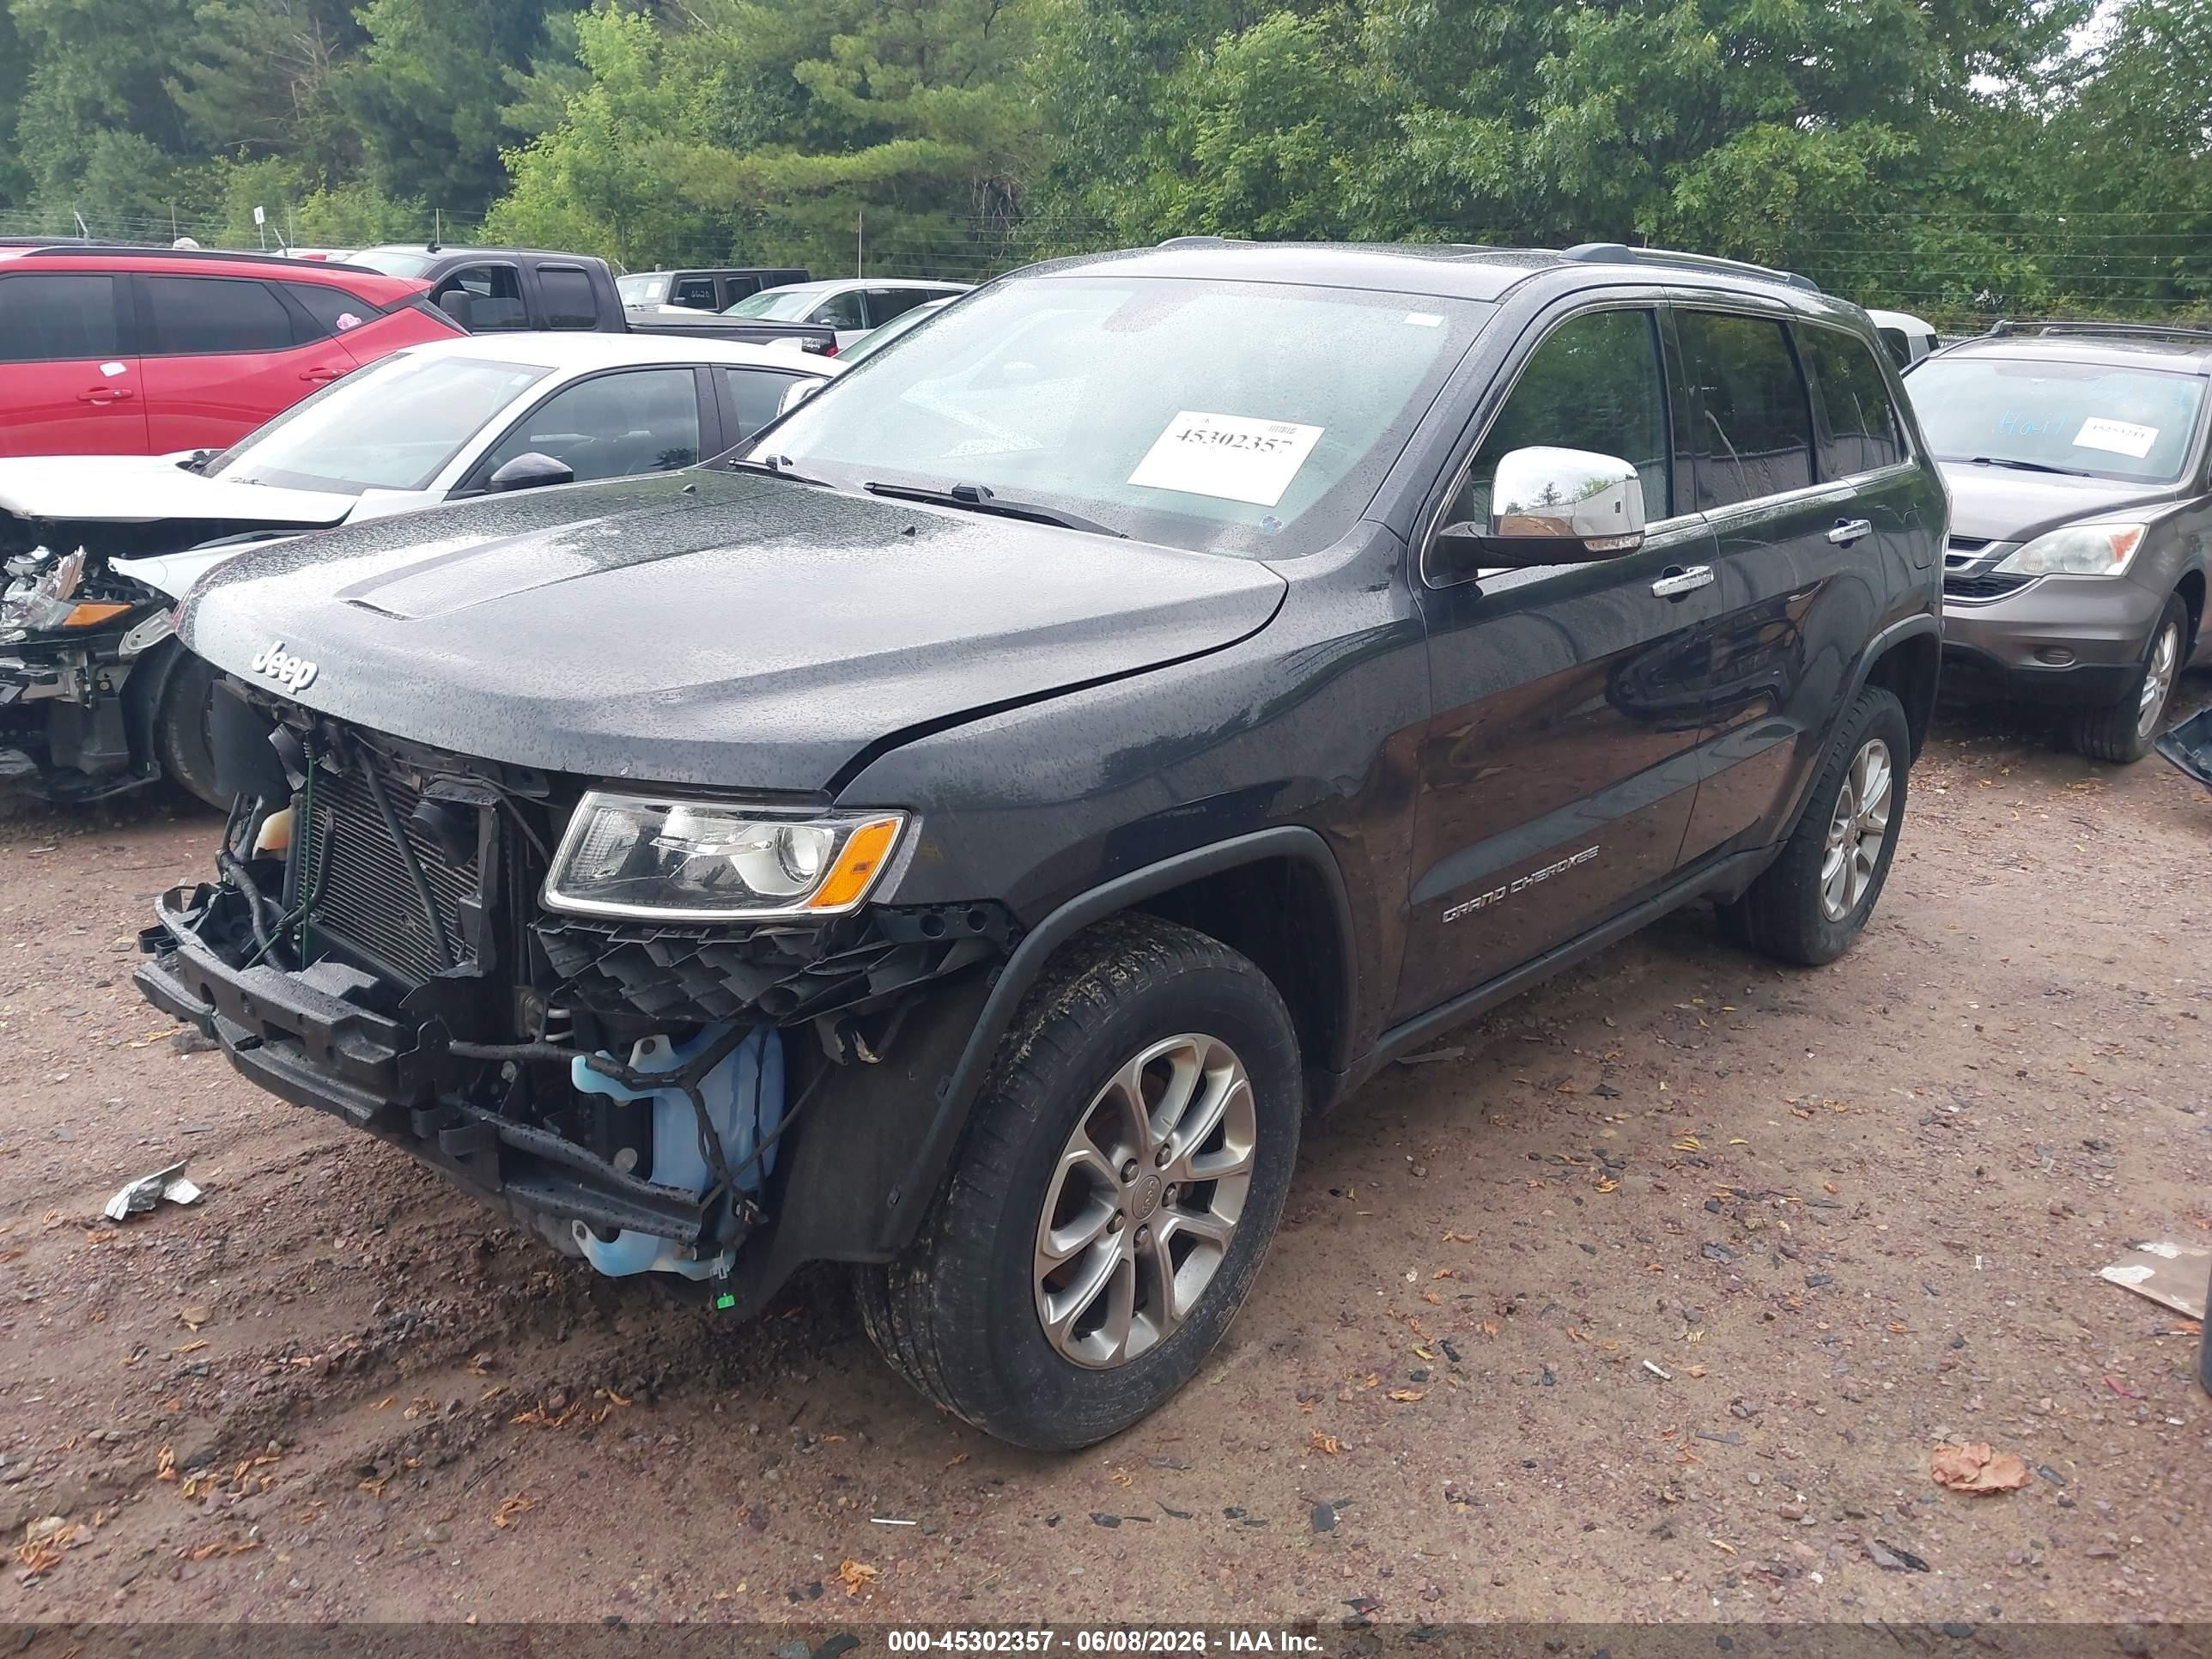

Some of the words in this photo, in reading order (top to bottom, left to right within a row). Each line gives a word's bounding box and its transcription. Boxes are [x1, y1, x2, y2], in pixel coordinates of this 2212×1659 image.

[1176, 428, 1293, 454] 45302357
[252, 640, 319, 695] Jeep
[1442, 885, 1507, 923] GRAND
[1510, 844, 1601, 894] CHEROKEE
